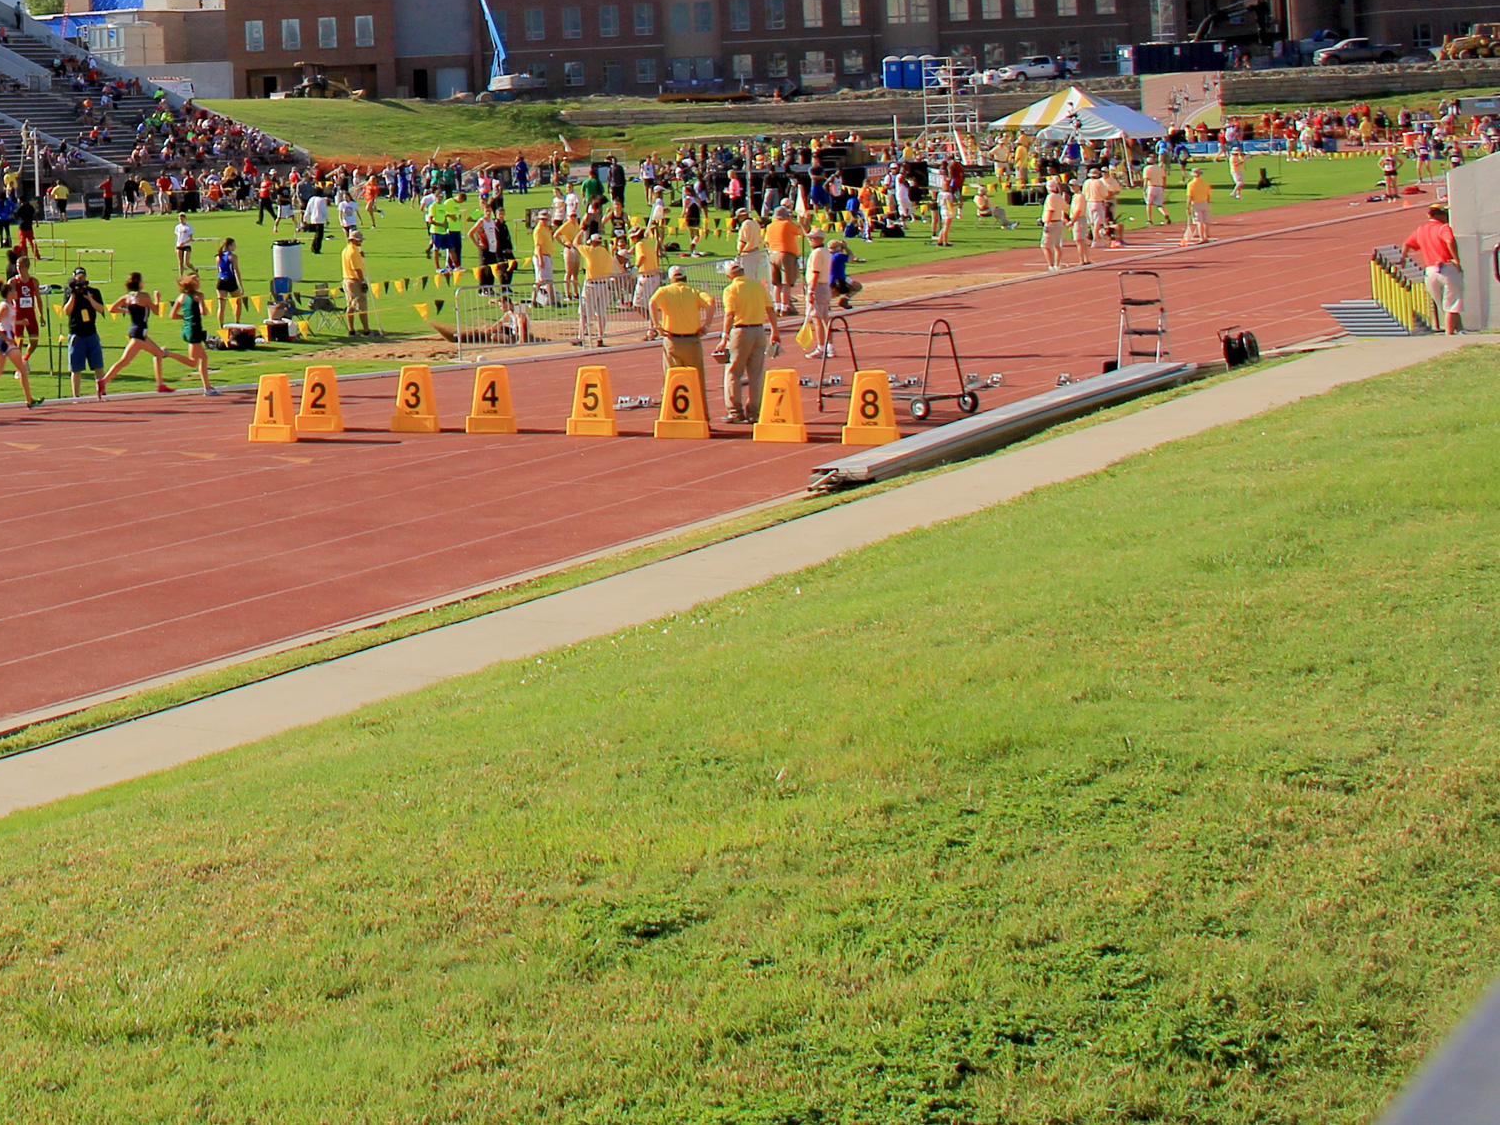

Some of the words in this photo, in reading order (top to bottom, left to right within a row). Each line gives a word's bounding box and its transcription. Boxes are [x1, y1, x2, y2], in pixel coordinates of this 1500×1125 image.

[264, 391, 275, 418] 1
[310, 382, 327, 409] 2
[404, 381, 421, 409] 3
[481, 380, 499, 408] 4
[582, 383, 599, 411] 5
[672, 384, 690, 414] 6
[770, 387, 787, 417] 7
[860, 389, 880, 419] 8
